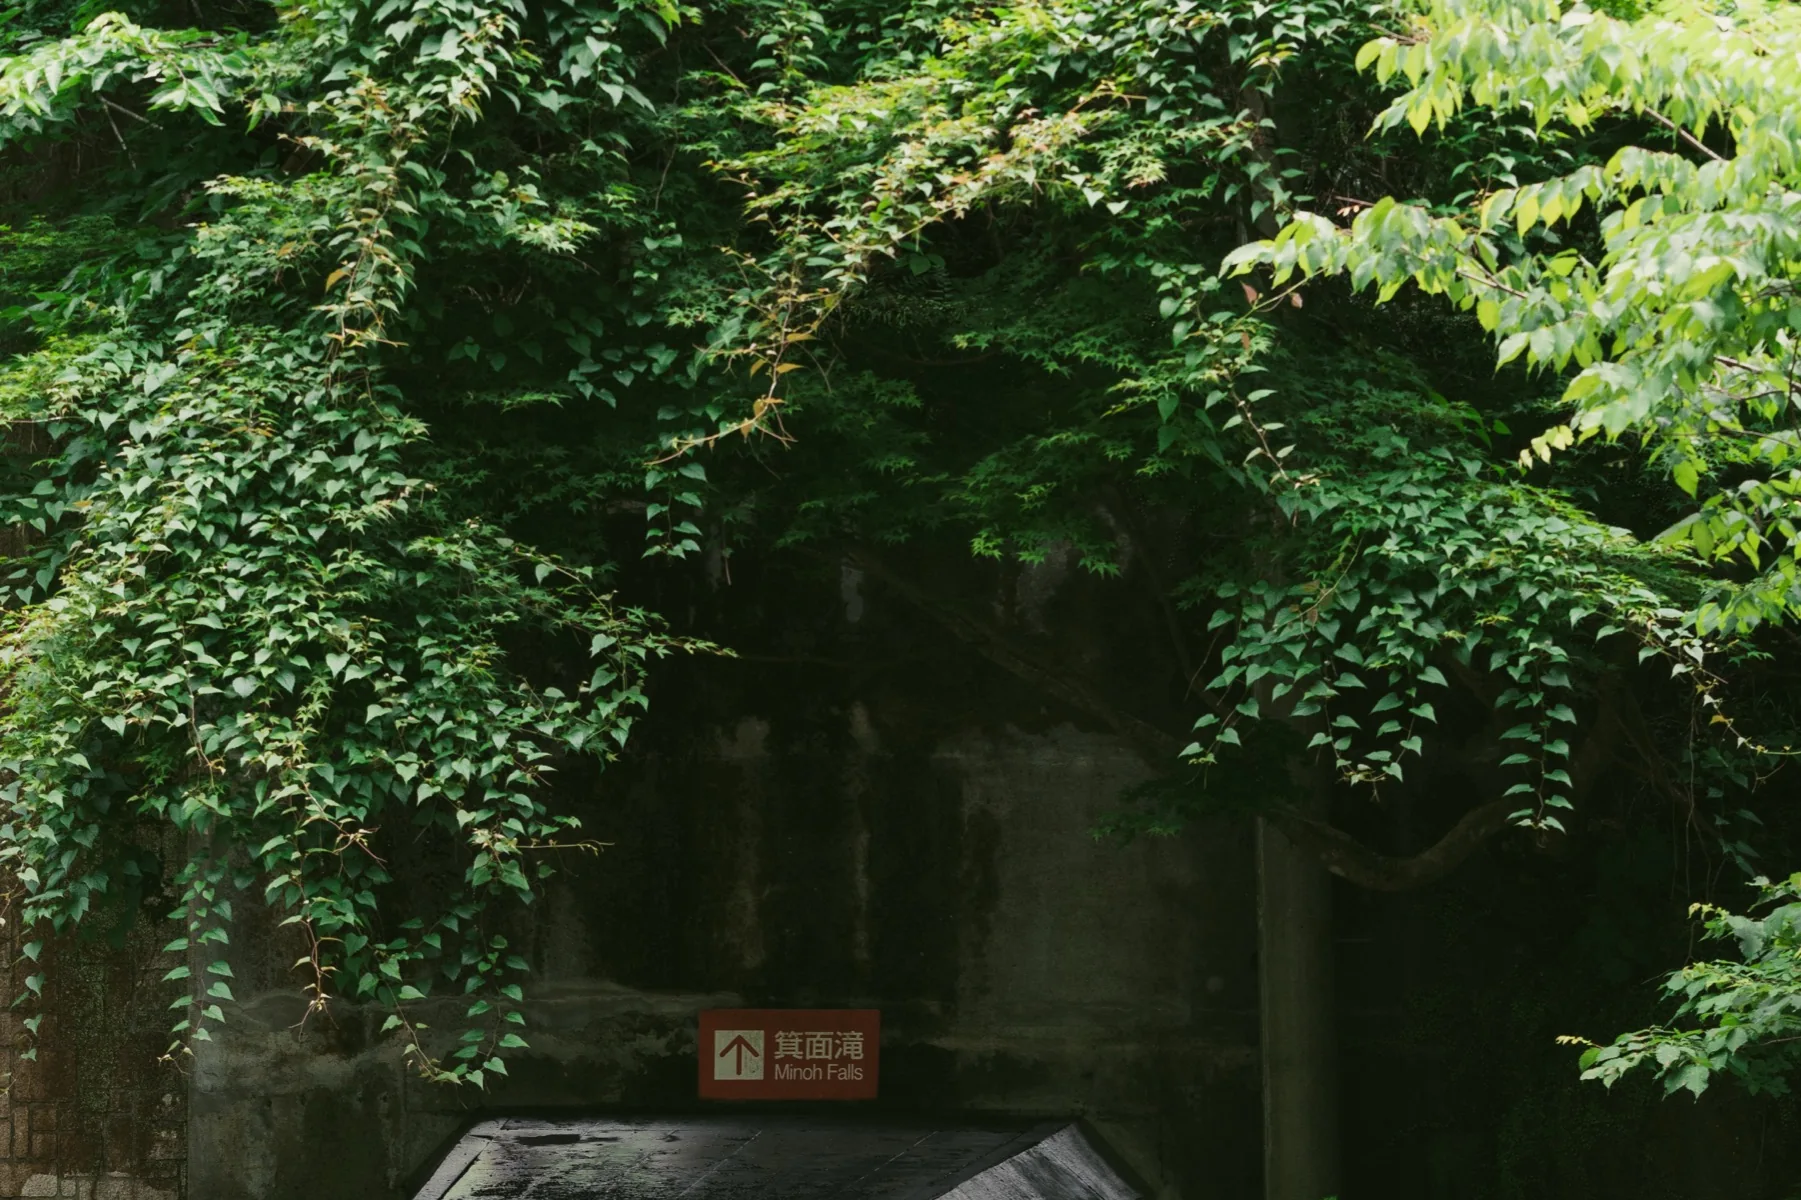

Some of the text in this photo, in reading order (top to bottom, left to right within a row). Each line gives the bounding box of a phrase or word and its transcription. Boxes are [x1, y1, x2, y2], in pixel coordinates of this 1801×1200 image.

[774, 1030, 864, 1060] 箕面滝
[774, 1064, 864, 1081] Minoh Falls
